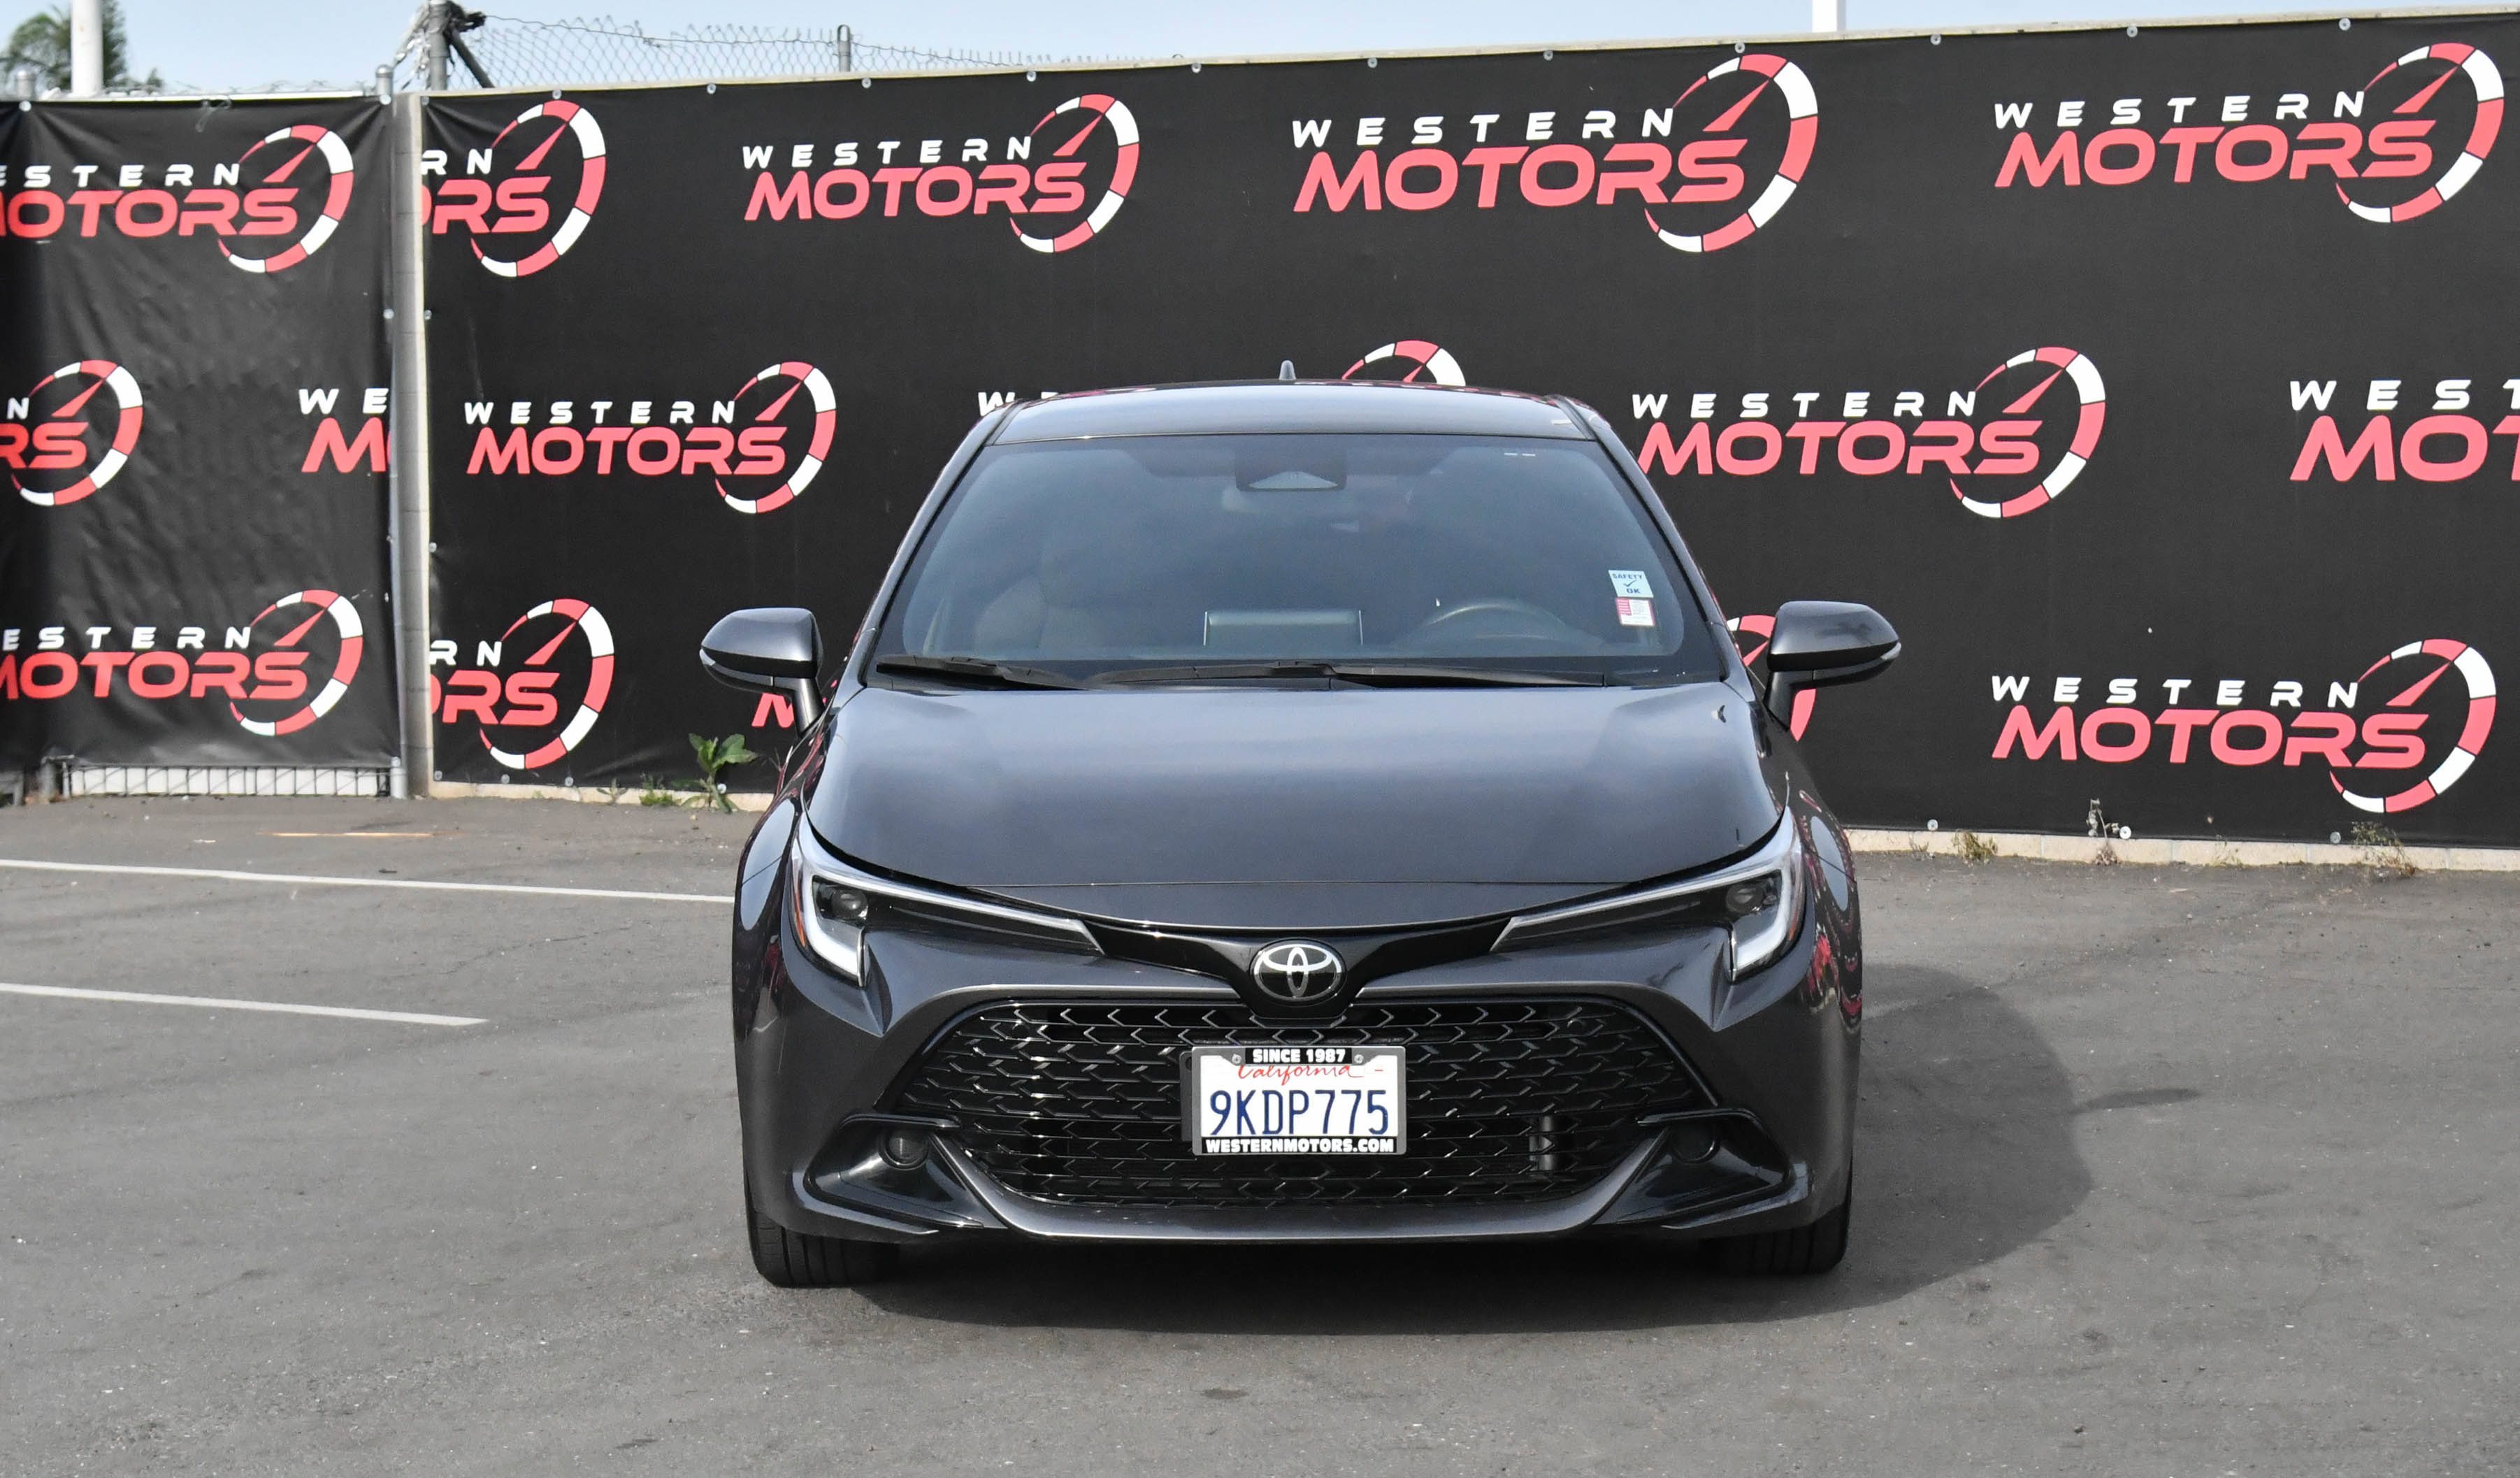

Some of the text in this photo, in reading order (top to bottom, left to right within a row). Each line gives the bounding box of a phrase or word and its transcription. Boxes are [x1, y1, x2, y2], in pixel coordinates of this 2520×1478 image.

[1292, 108, 1673, 148] WESTERN
[1994, 92, 2365, 129] WESTERN
[742, 136, 1032, 169] WESTERN
[1994, 120, 2437, 188] MOTORS
[744, 162, 1087, 221] MOTORS
[1293, 139, 1748, 212] MOTORS
[0, 188, 299, 238] OTORS
[464, 400, 735, 424] WESTERN
[1632, 391, 1976, 419] WESTERN
[466, 426, 787, 475] MOTORS
[1638, 420, 2043, 476] MOTORS
[3, 626, 251, 651] ESTERN
[1992, 675, 2359, 708] WESTERN
[1992, 705, 2429, 769] MOTORS
[1252, 1048, 1346, 1063] SINCE 1987
[1238, 1064, 1364, 1086] California
[1210, 1089, 1389, 1135] 9KDP775
[1206, 1138, 1394, 1154] WESTERNMOTORS.COM
